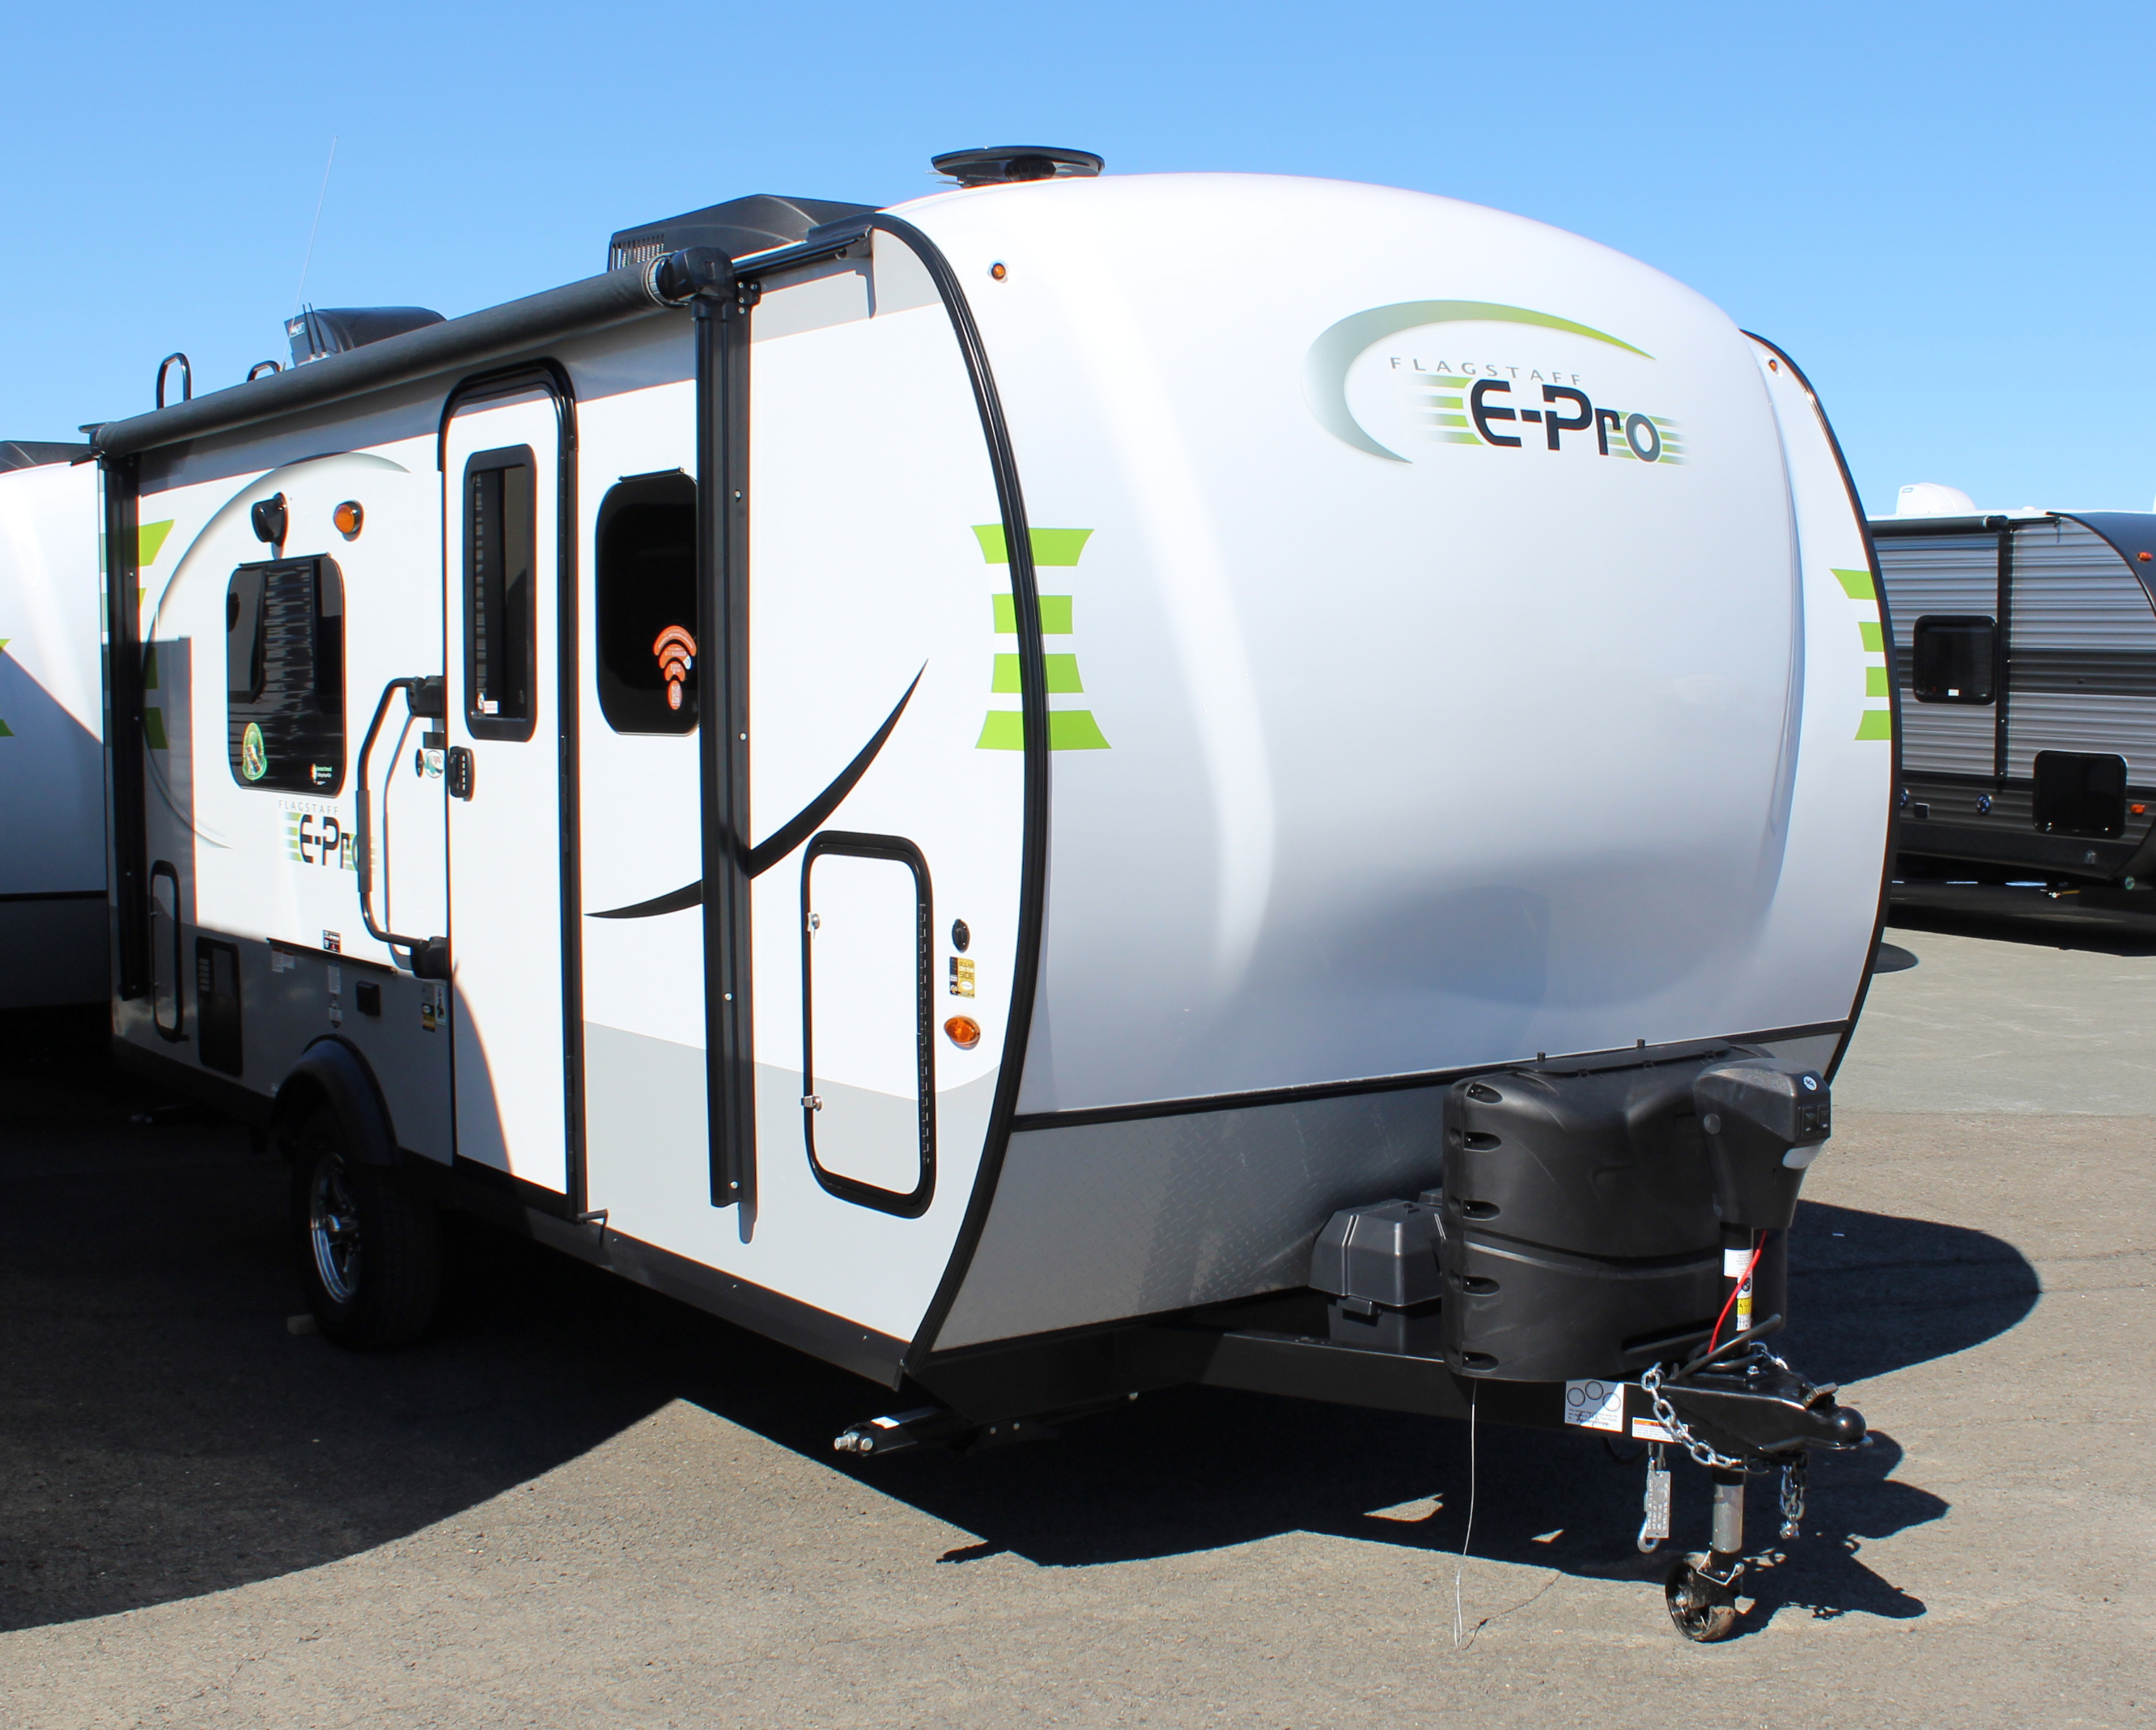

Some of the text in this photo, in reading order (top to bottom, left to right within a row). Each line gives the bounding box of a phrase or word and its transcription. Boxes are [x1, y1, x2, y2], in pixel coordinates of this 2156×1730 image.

[1390, 357, 1582, 386] FLAGSTAFF
[1470, 379, 1662, 464] E-Pro
[278, 799, 339, 816] FLAGSTAFF
